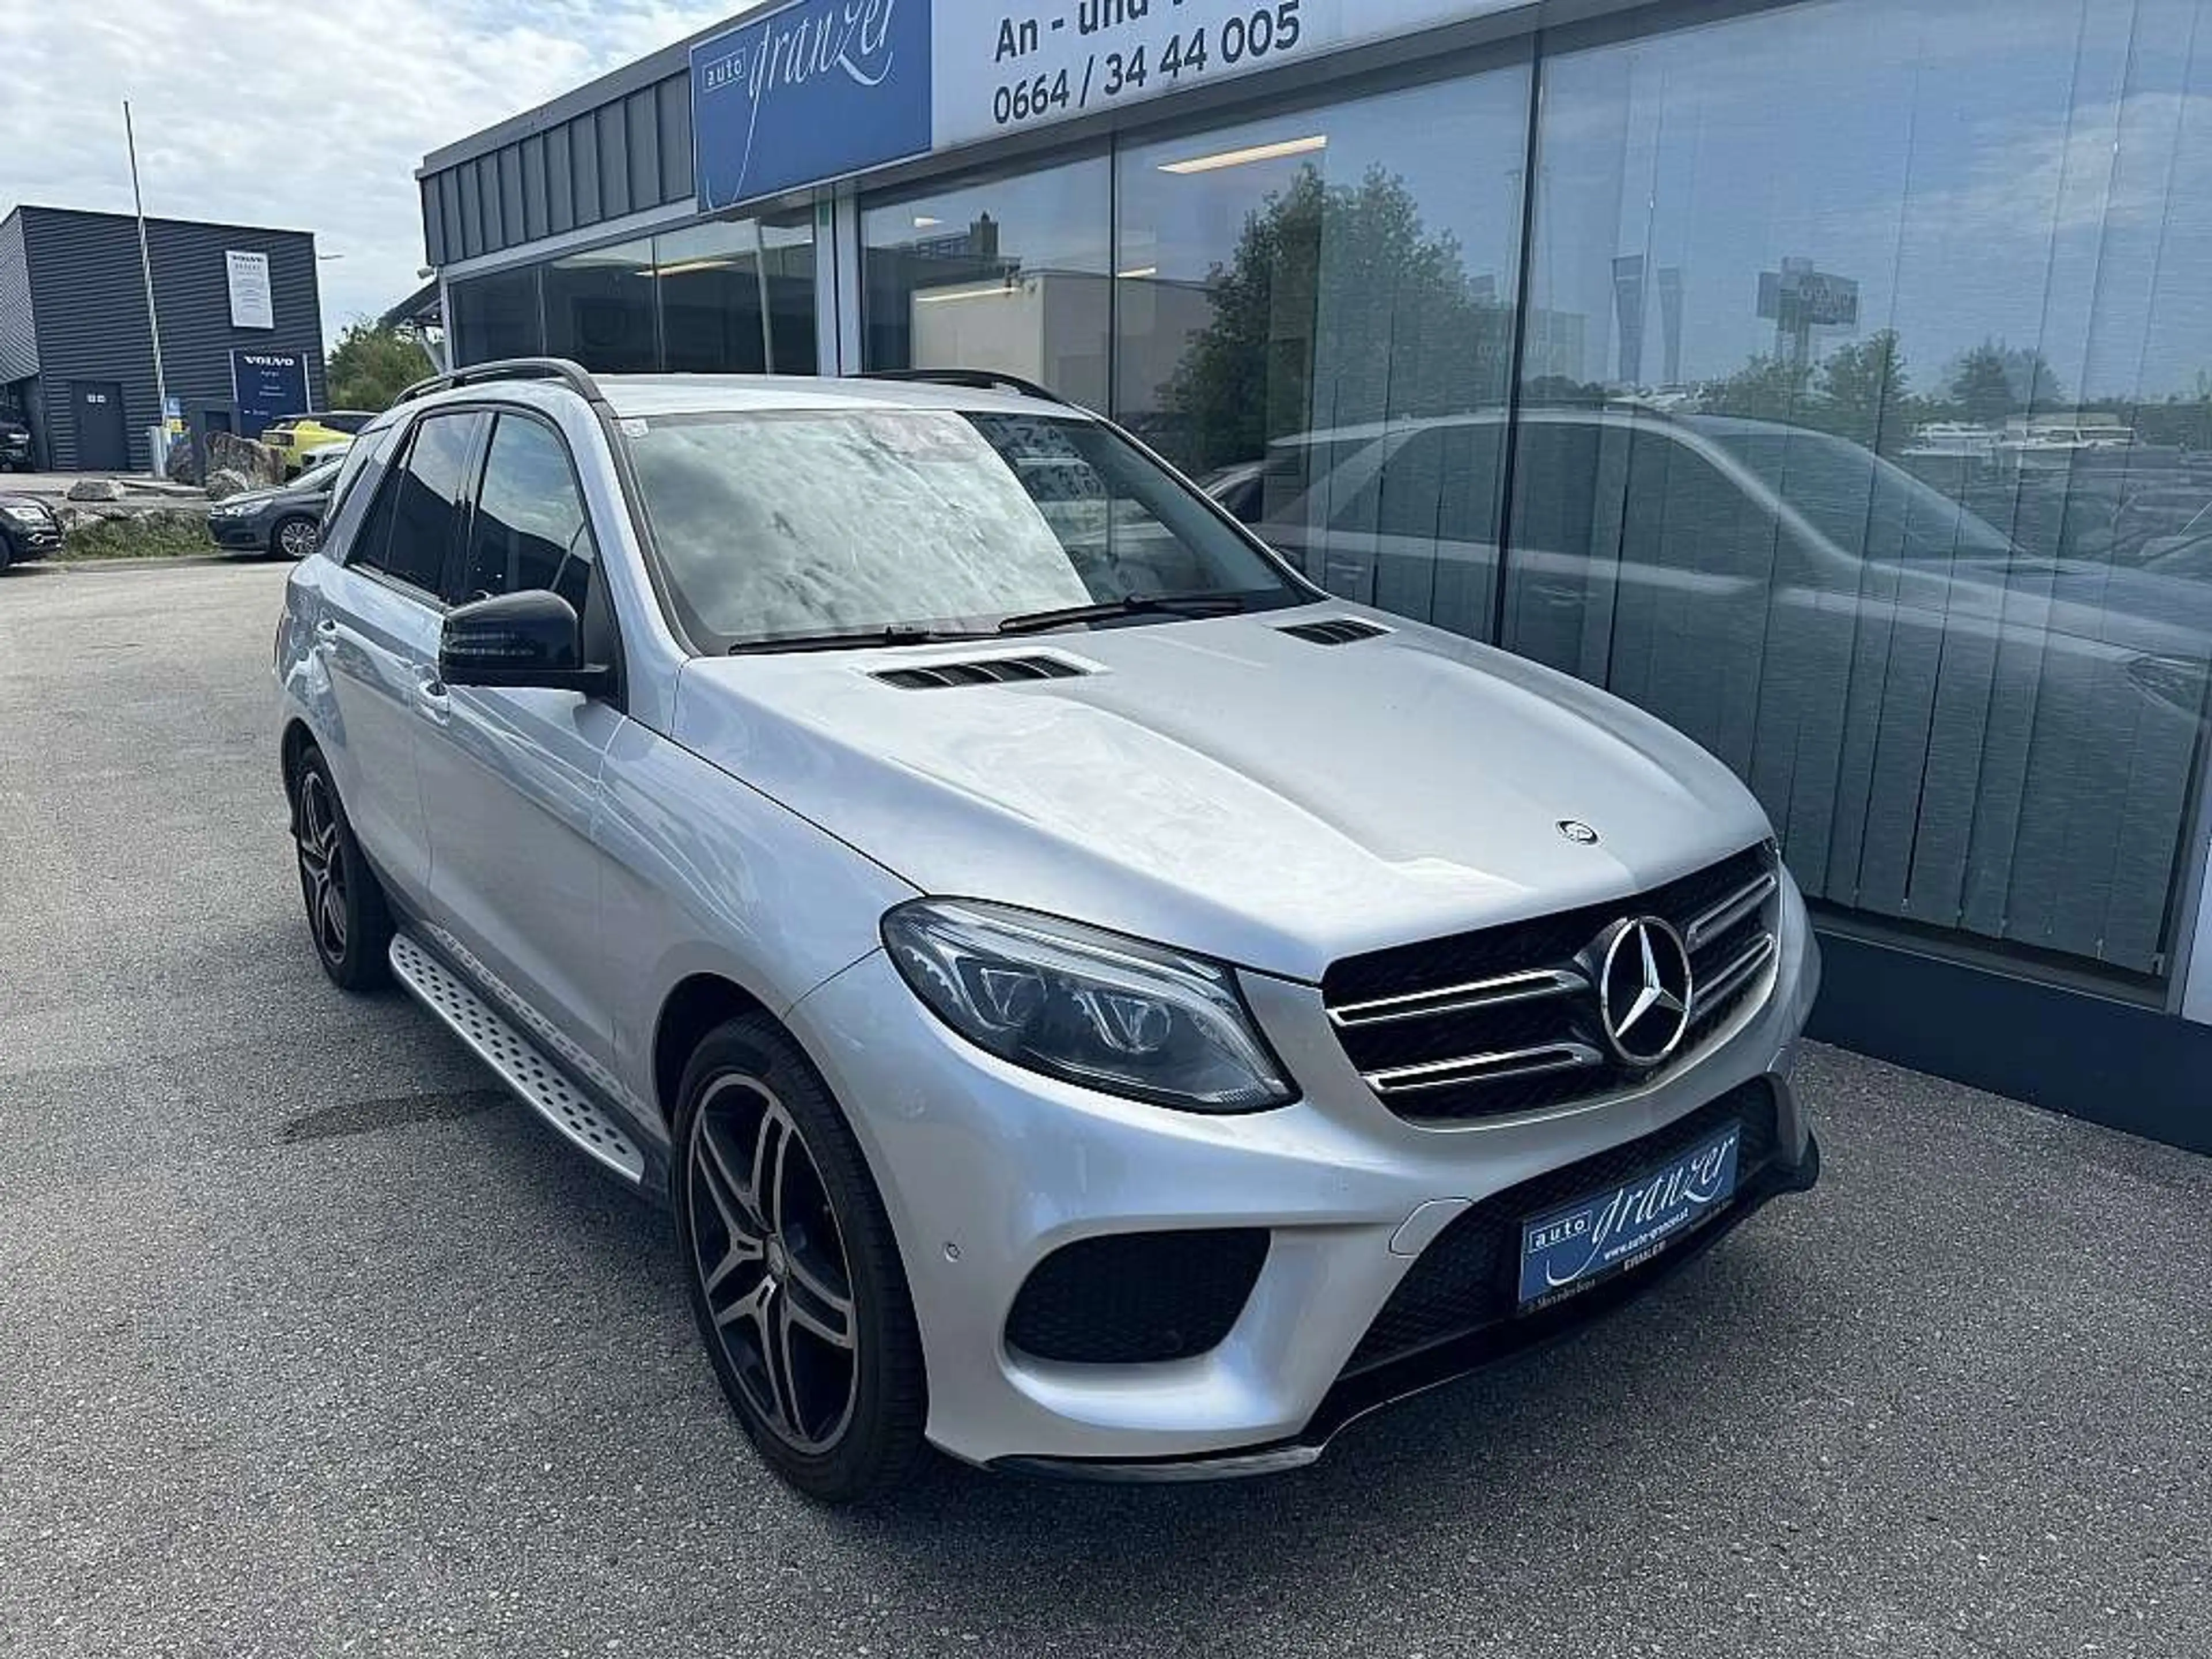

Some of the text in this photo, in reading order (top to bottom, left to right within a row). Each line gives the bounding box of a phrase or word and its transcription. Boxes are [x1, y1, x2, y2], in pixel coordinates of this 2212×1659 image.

[995, 17, 1038, 62] An
[1051, 18, 1064, 31] -
[707, 59, 743, 86] auto
[994, 2, 1300, 124] 0664 / 34 44 005
[244, 356, 295, 366] VOLVO
[1535, 1136, 1735, 1286] auto granzer
